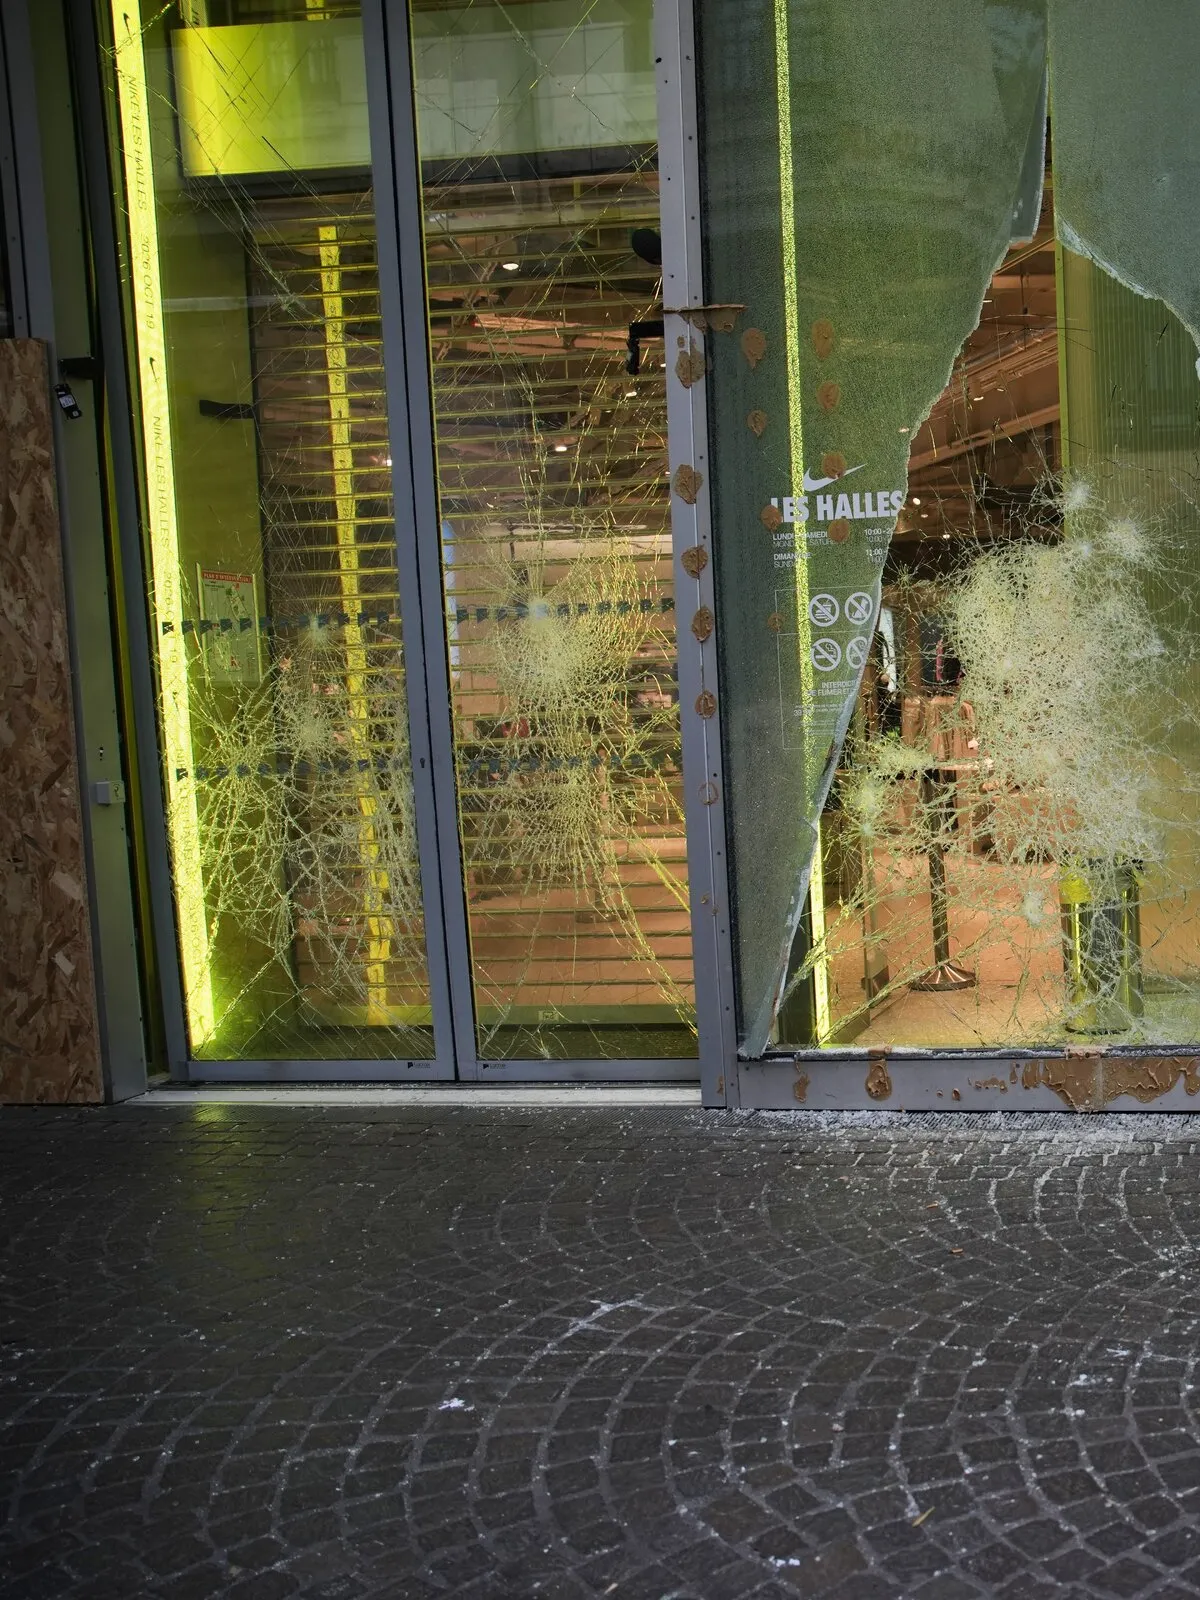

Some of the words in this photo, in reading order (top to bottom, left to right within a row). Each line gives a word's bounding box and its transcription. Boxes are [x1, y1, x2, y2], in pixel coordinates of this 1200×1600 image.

[128, 74, 141, 112] NIKE
[131, 115, 143, 145] LES
[133, 149, 148, 211] HALLES
[144, 275, 155, 308] OCT
[146, 313, 155, 330] 19
[153, 415, 164, 450] NIKE
[155, 456, 166, 484] LES
[157, 488, 169, 548] HALLES
[817, 490, 903, 520] HALLES
[773, 533, 793, 541] LUNDI
[802, 531, 827, 540] AMEDI
[865, 528, 881, 536] 10:00
[773, 551, 812, 561] DIMANE
[865, 548, 882, 556] 11:00
